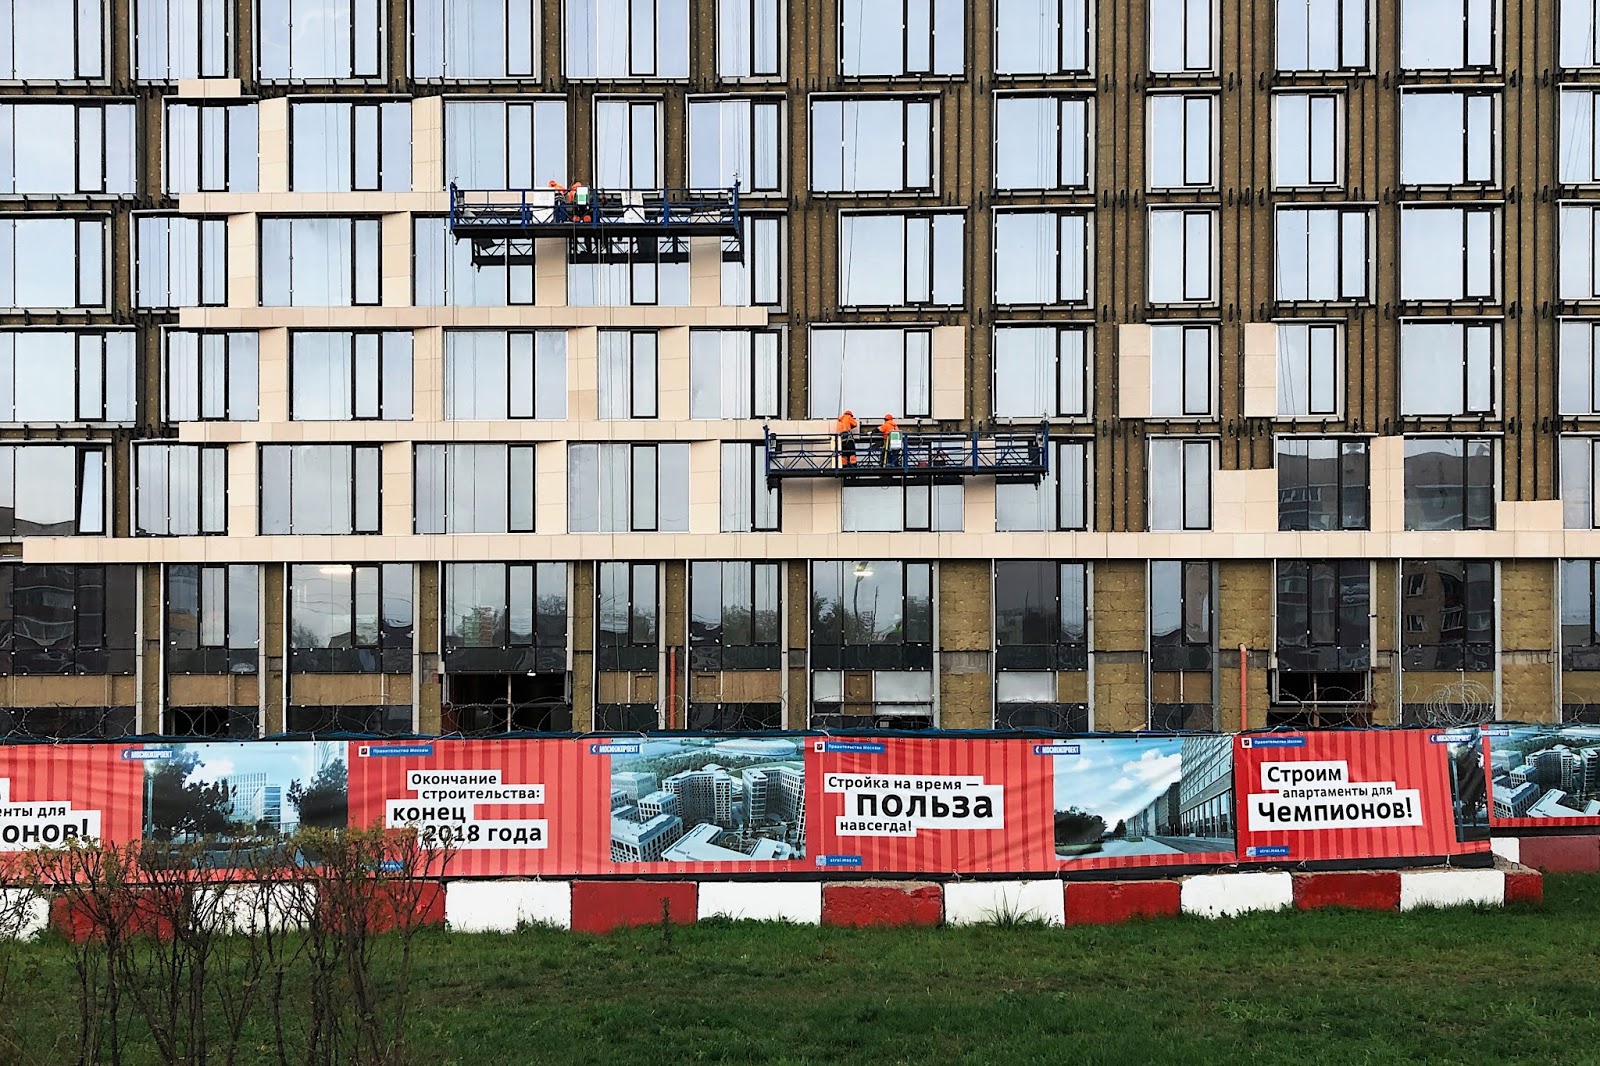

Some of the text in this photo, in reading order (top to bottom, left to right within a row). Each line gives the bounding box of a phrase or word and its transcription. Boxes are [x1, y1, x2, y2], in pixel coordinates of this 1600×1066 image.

[411, 773, 497, 785] Окончание
[1267, 767, 1342, 784] Строим
[828, 776, 889, 790] Стройка
[894, 780, 911, 789] на
[916, 780, 961, 792] время
[422, 787, 540, 802] строительства:
[1283, 786, 1393, 799] апартаменты для
[0, 807, 66, 818] нты для
[393, 805, 466, 824] конец
[1258, 797, 1413, 823] Чемпионов!
[840, 820, 912, 832] навсегда!
[423, 824, 542, 844] 2018 года
